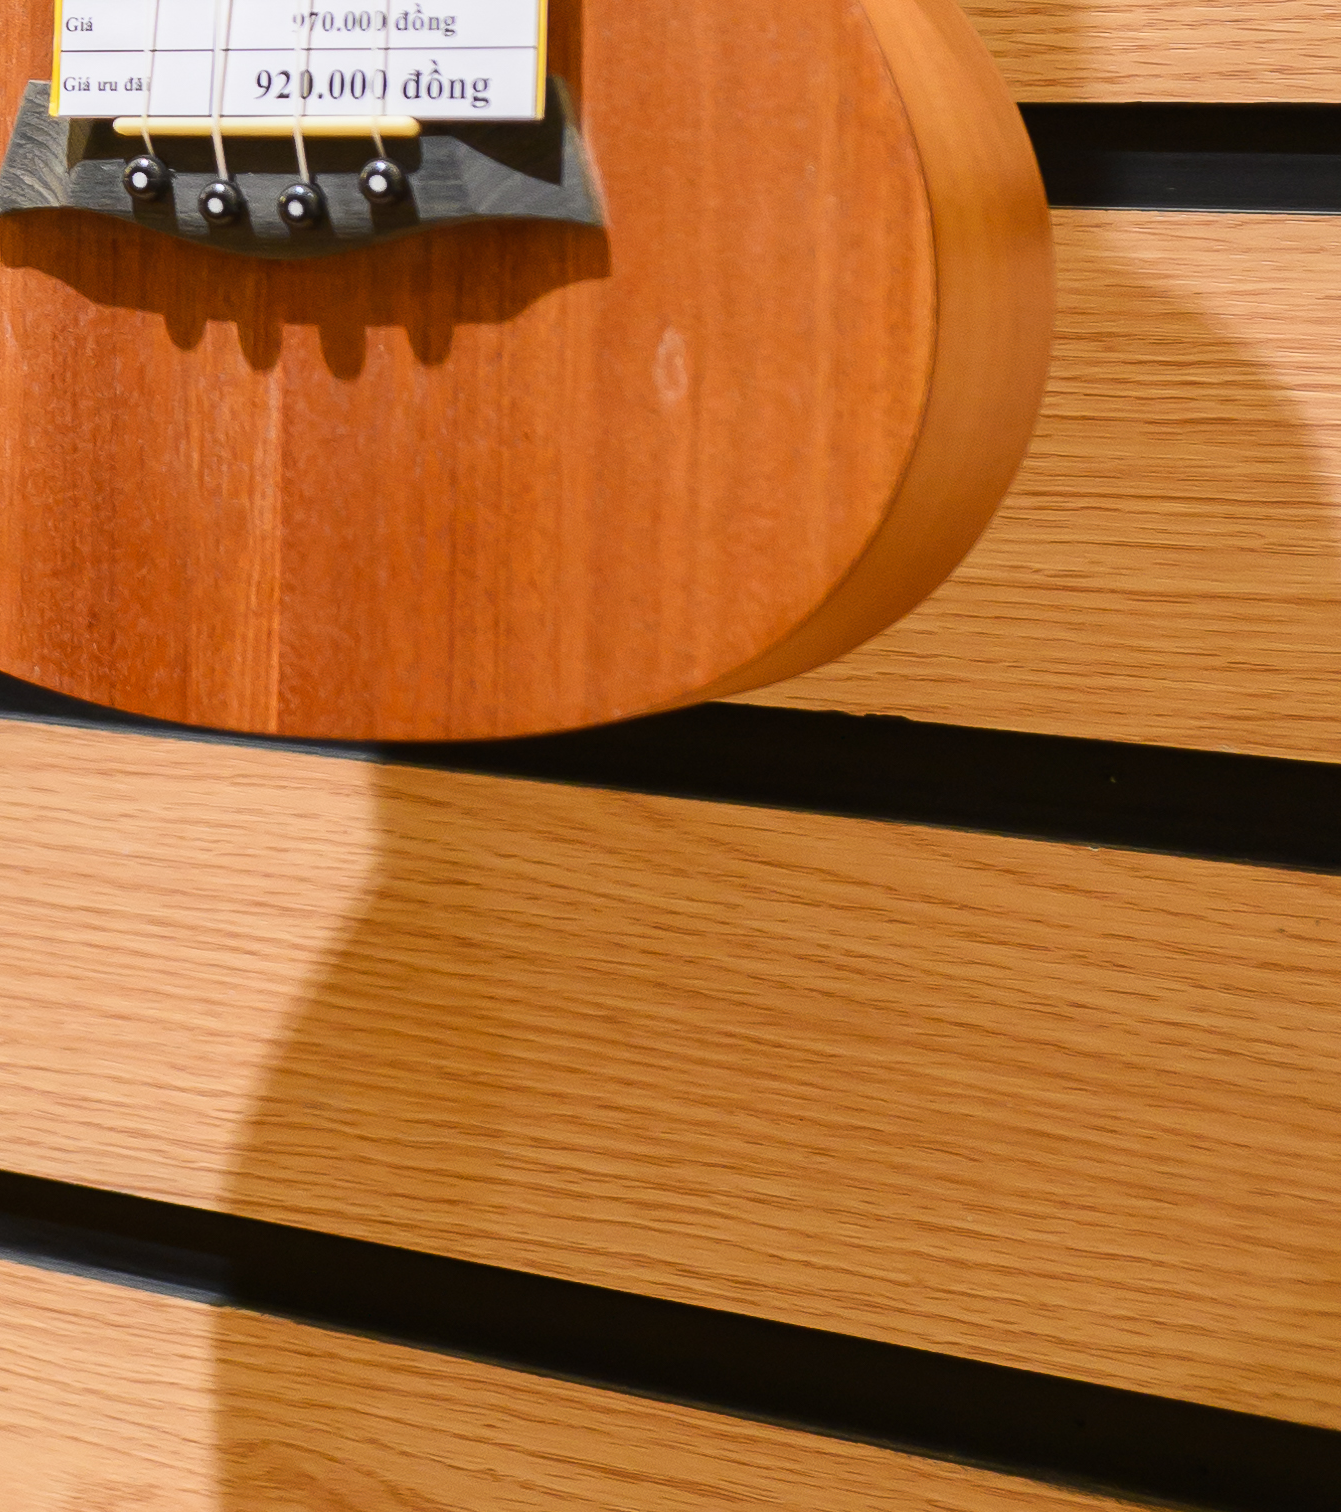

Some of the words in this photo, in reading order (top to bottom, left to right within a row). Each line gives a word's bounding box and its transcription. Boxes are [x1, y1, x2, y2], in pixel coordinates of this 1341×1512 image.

[65, 17, 93, 32] Giá
[293, 10, 388, 32] 970.000
[395, 3, 456, 37] đồng
[63, 76, 91, 92] Giá
[254, 68, 388, 100] 920.000
[403, 59, 492, 108] đồng
